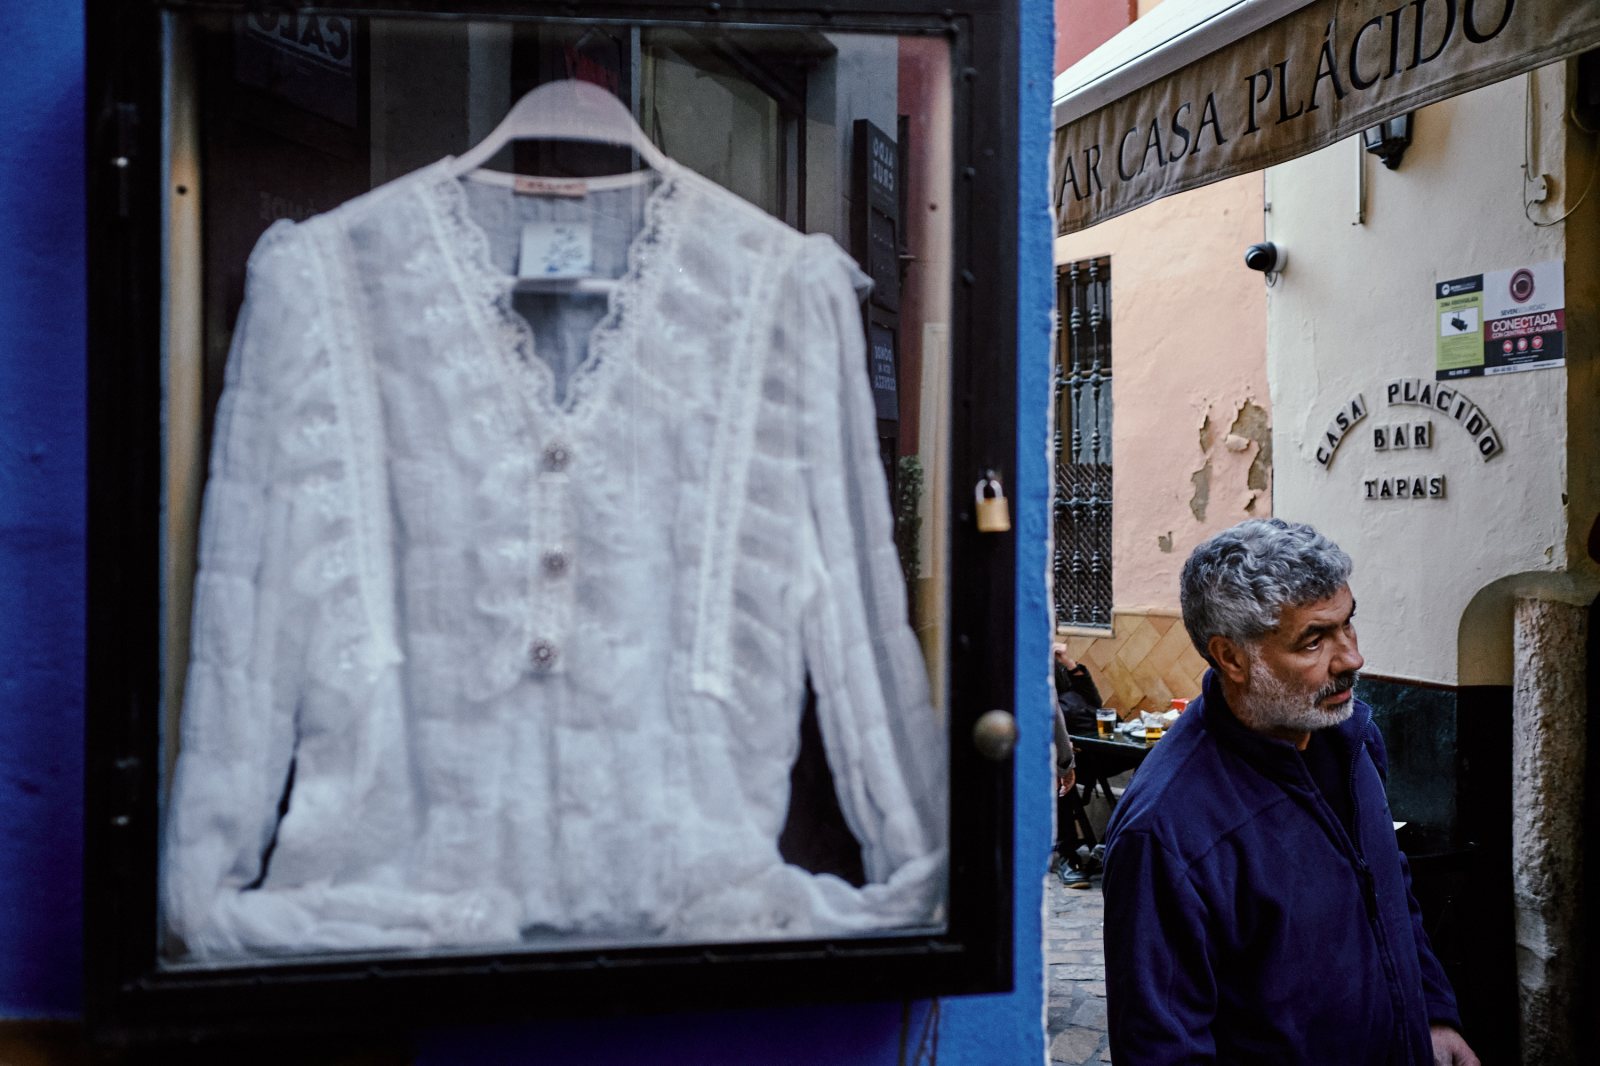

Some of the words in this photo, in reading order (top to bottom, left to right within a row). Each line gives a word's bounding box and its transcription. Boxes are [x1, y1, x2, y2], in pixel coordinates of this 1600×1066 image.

[1054, 144, 1104, 208] AR
[1118, 97, 1227, 182] CASA
[1243, 0, 1516, 136] PLÁCIDO
[1491, 313, 1558, 332] CONECTADA
[1316, 400, 1362, 465] CASA
[1387, 382, 1496, 456] PLACIDO
[1374, 425, 1427, 448] BAR
[1364, 477, 1442, 498] TAPAS
